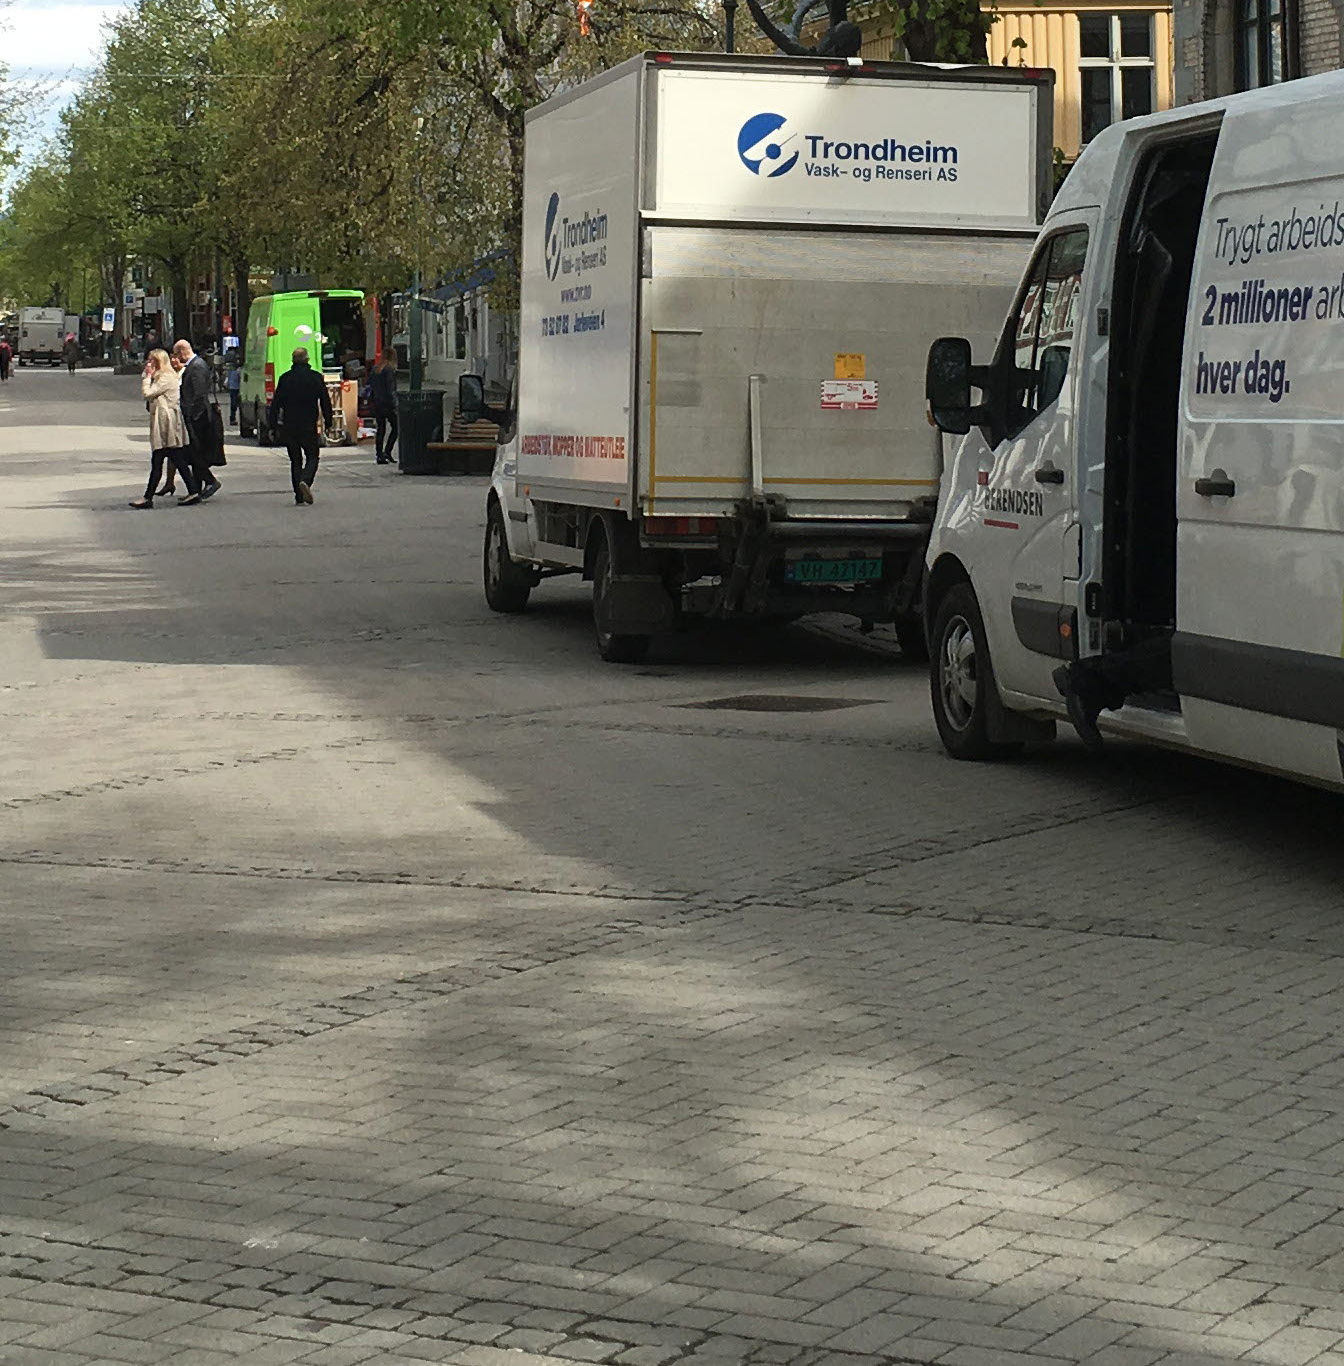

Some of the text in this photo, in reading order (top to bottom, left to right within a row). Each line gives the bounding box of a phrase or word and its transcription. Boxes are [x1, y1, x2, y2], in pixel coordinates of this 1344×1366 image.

[805, 135, 958, 164] Trondheim
[805, 162, 958, 182] Vask- og Renseri AS
[563, 208, 607, 249] Trondheim
[1215, 214, 1266, 265] Trygt
[1202, 285, 1218, 326] 2
[1218, 279, 1314, 325] millioner
[1195, 349, 1290, 403] hver dag.
[985, 488, 1043, 516] BERENDSEN
